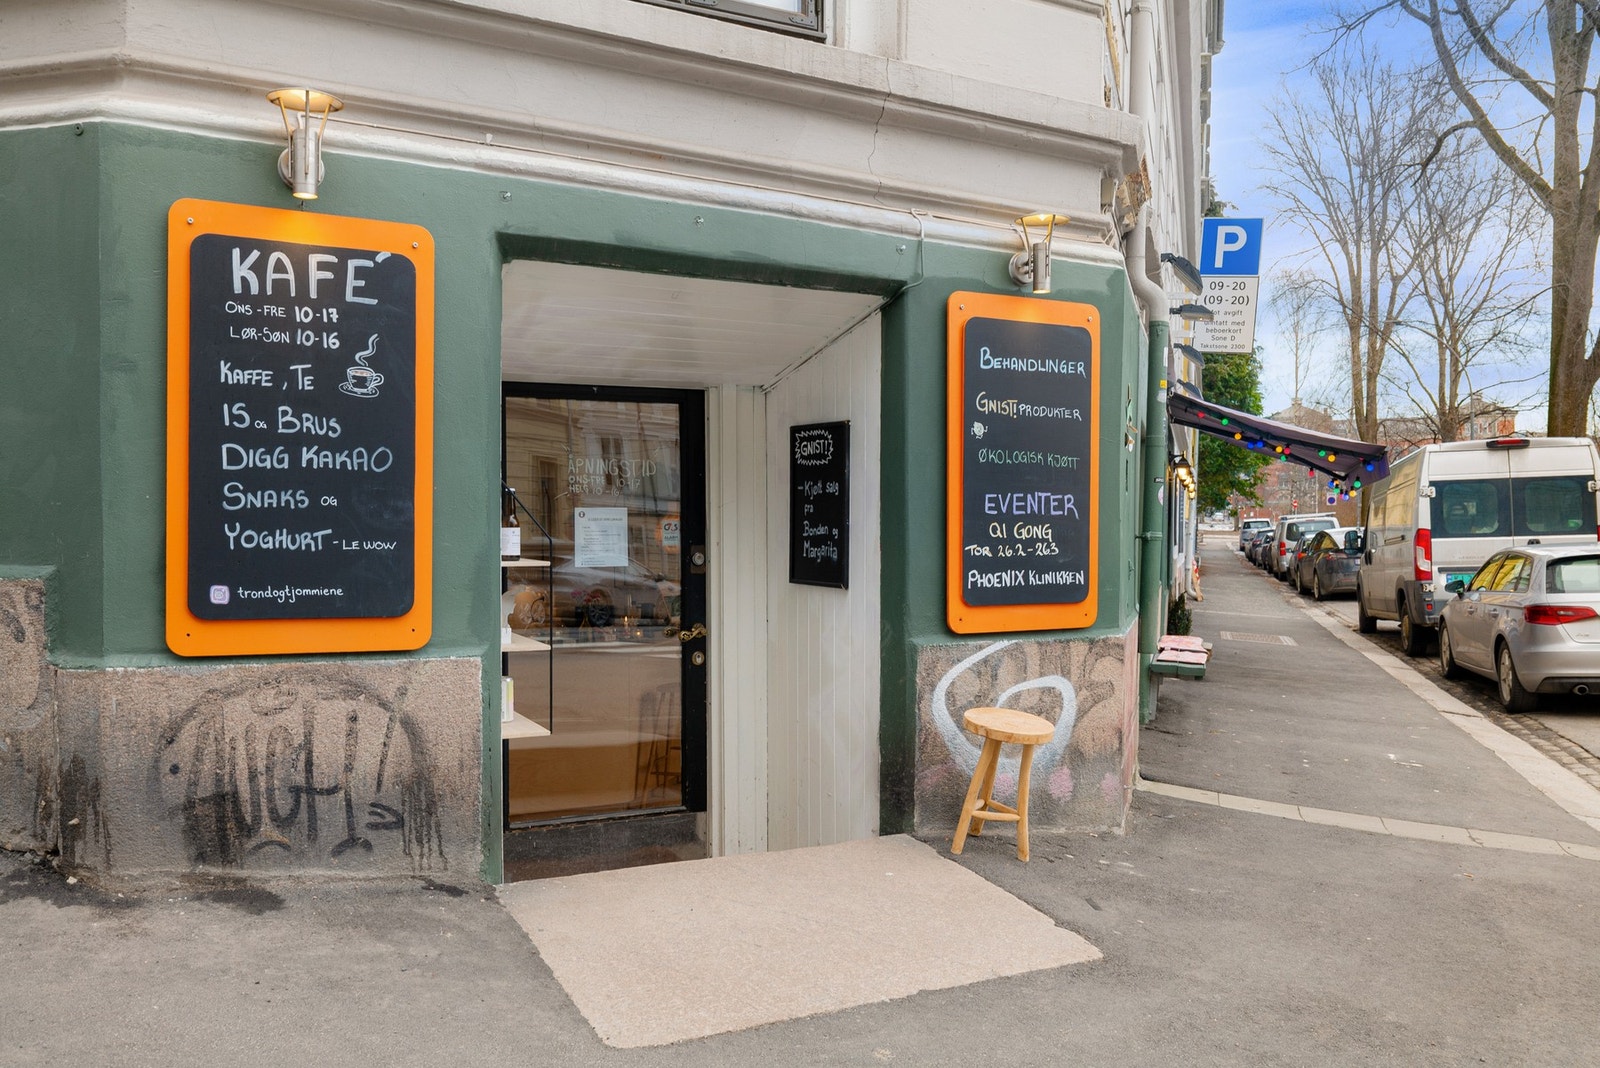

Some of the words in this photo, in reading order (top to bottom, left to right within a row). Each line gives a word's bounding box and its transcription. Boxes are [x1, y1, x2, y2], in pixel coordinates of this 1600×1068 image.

[1214, 225, 1248, 269] P
[231, 246, 392, 305] KAFÉ
[294, 306, 339, 323] 10-17
[296, 328, 340, 349] 10-16
[980, 346, 1087, 378] BEHANDLINGER
[290, 364, 315, 390] TE
[223, 403, 251, 428] IS
[278, 406, 342, 438] BRUS
[221, 443, 290, 471] DIGG
[301, 444, 393, 473] KAKAO
[800, 440, 828, 456] GNIST!
[978, 447, 1044, 464] ØKOLOGISK
[1047, 453, 1081, 470] KJØTT
[222, 482, 310, 511] SNAKS
[984, 491, 1079, 520] EVENTER
[224, 522, 333, 552] YOGHURT
[342, 540, 360, 551] LE
[989, 522, 1007, 539] QI
[1013, 521, 1052, 542] GONG
[964, 544, 993, 558] TOR
[968, 569, 1025, 589] PHOENIX
[1028, 570, 1085, 586] KLINIKKEN
[237, 585, 344, 603] trondogtjommiene
